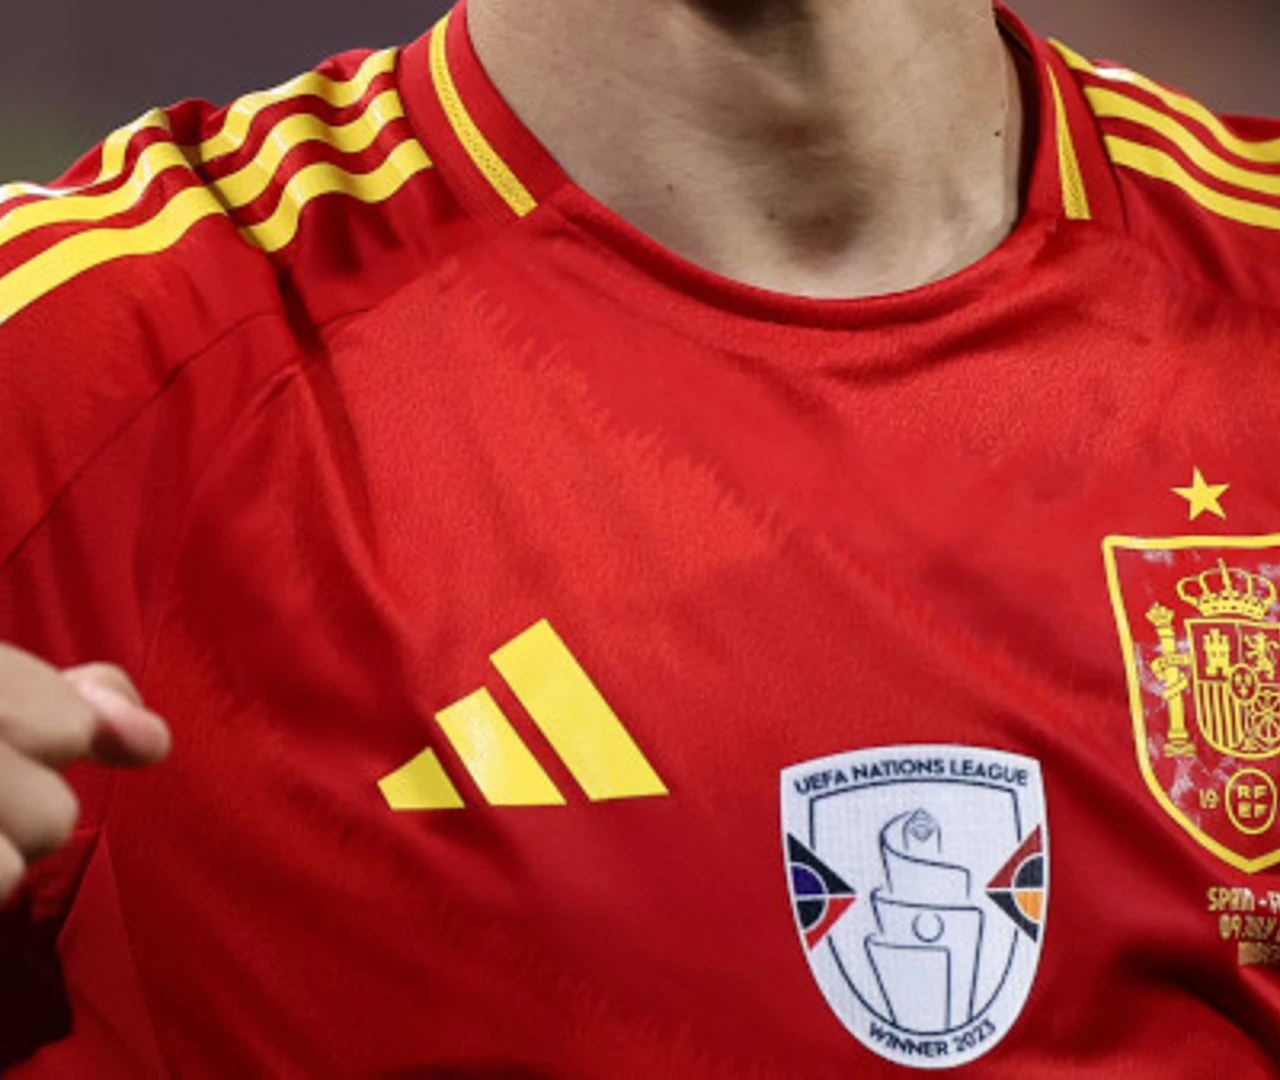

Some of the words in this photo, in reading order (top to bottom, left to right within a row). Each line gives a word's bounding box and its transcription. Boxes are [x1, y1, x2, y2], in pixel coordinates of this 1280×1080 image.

[793, 769, 848, 795] UEFA
[851, 758, 945, 780] NATIONS
[949, 758, 1028, 786] LEAGUE
[1237, 785, 1267, 799] RF
[869, 1021, 948, 1057] WINNER
[951, 1018, 996, 1051] 2023
